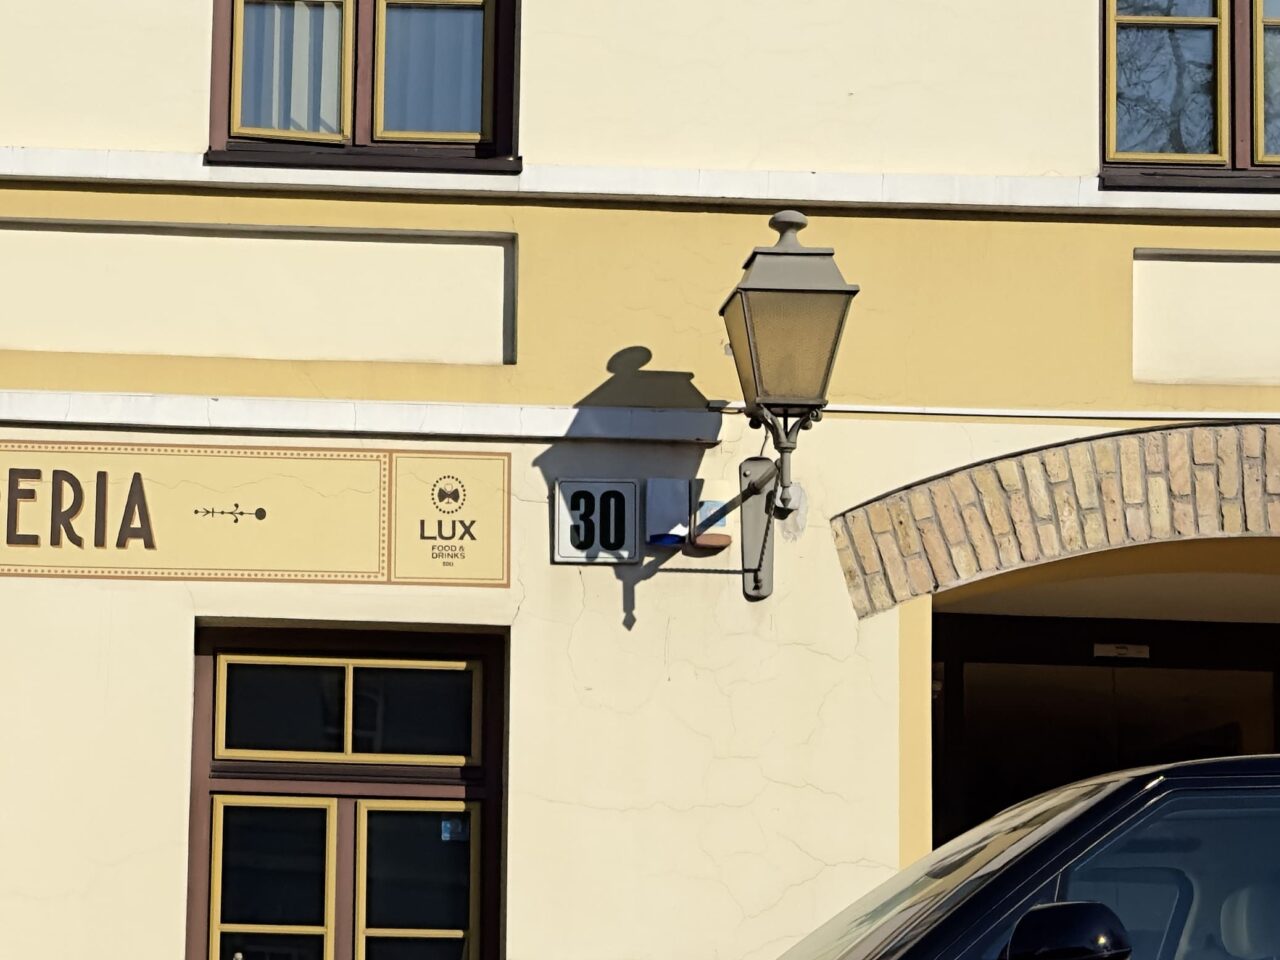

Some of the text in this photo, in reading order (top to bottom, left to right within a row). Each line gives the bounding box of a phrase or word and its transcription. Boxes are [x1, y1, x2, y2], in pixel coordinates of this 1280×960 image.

[569, 489, 626, 550] 30
[419, 519, 477, 541] LUX
[431, 544, 457, 552] FOOD
[431, 552, 466, 560] DRINKS
